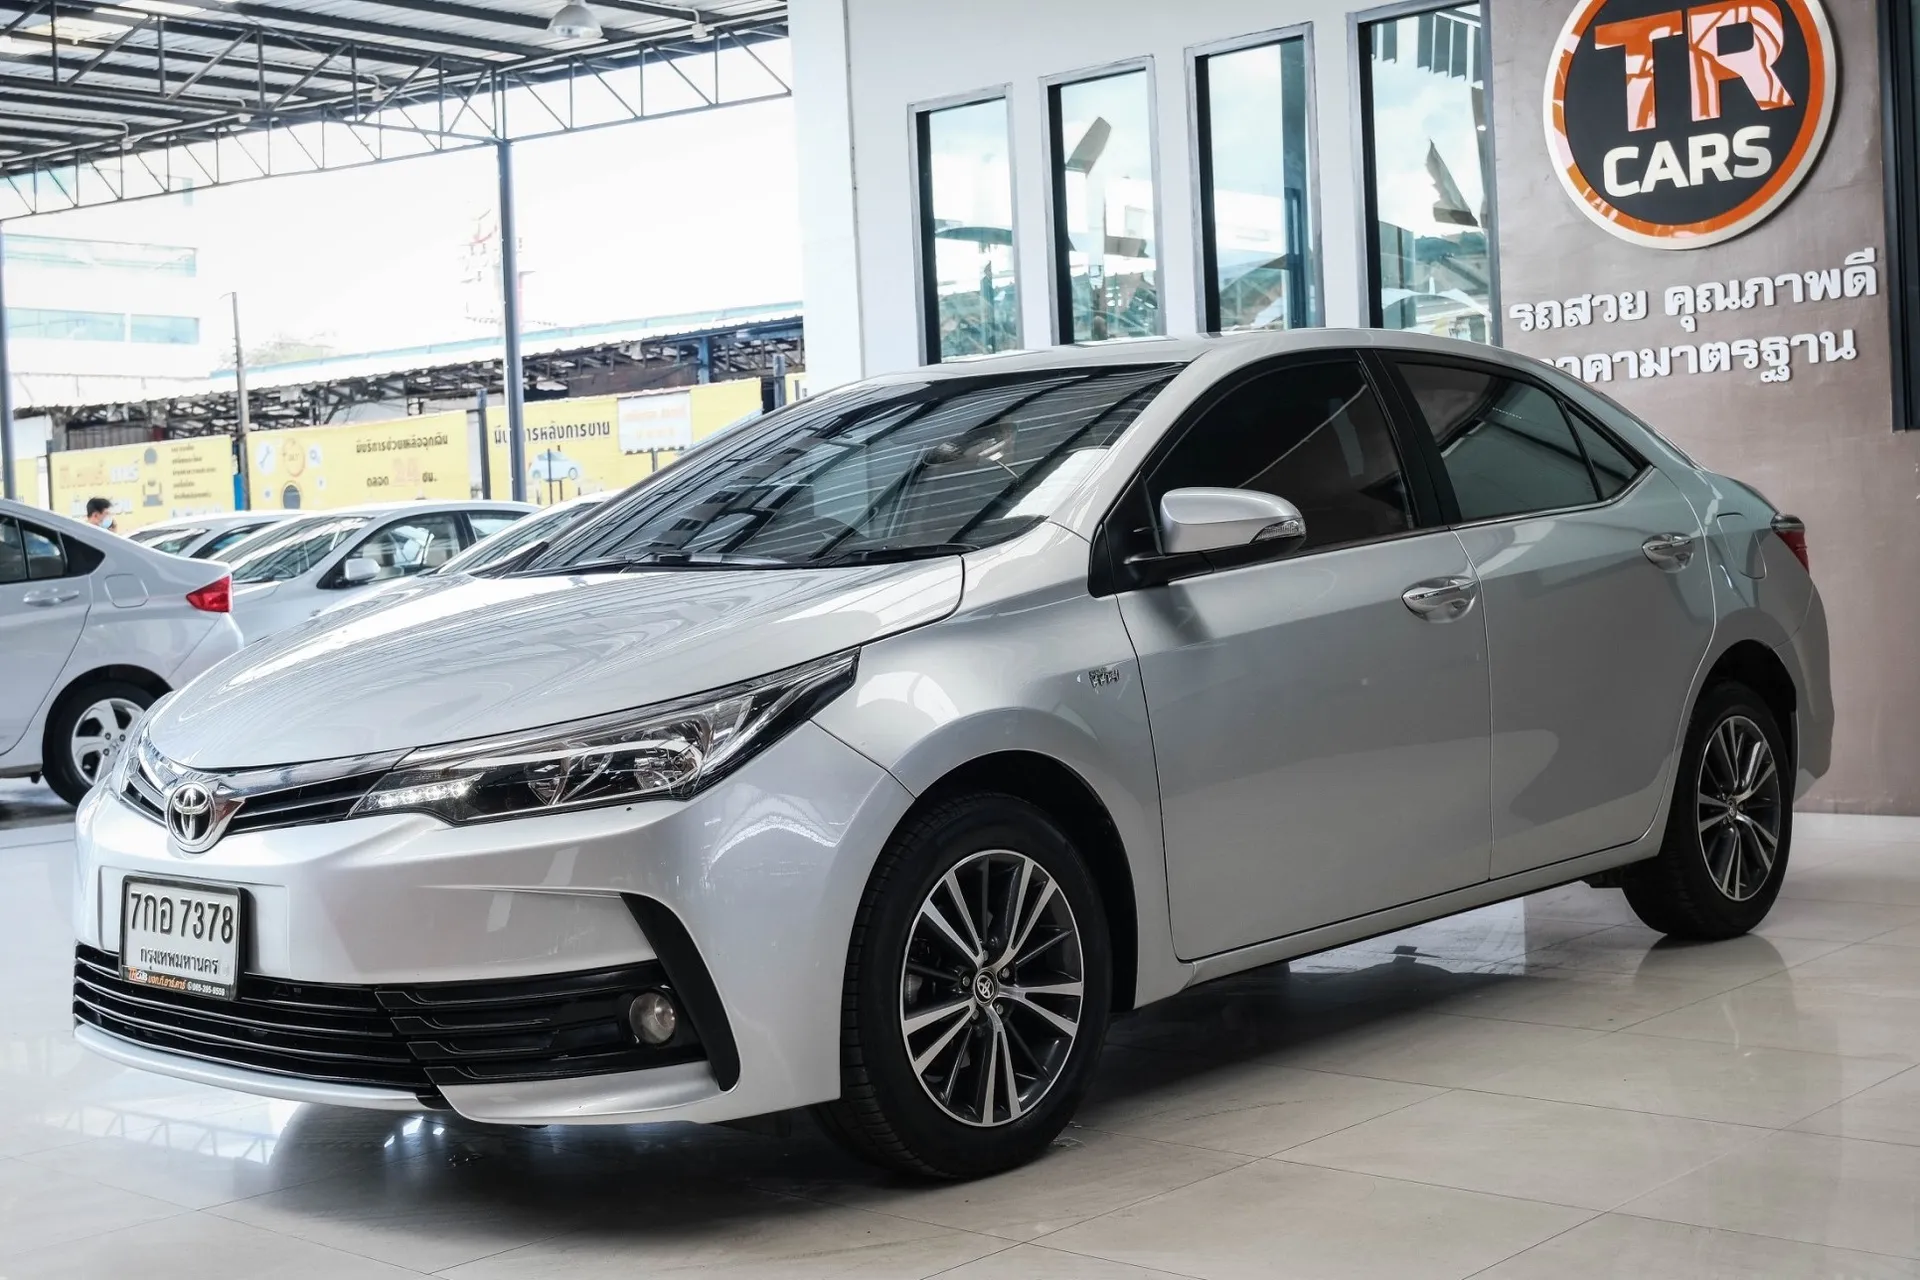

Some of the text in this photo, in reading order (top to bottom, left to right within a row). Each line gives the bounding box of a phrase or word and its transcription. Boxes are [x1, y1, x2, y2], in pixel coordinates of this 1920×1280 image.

[1594, 0, 1795, 132] TR
[1602, 125, 1773, 198] CARS
[1509, 248, 1878, 333] รถสวย คุณภาพดี
[1537, 328, 1857, 383] าคามาตรฐาน
[131, 893, 234, 944] 7กอ 7378
[140, 947, 219, 975] กรุงเทพมหานคร
